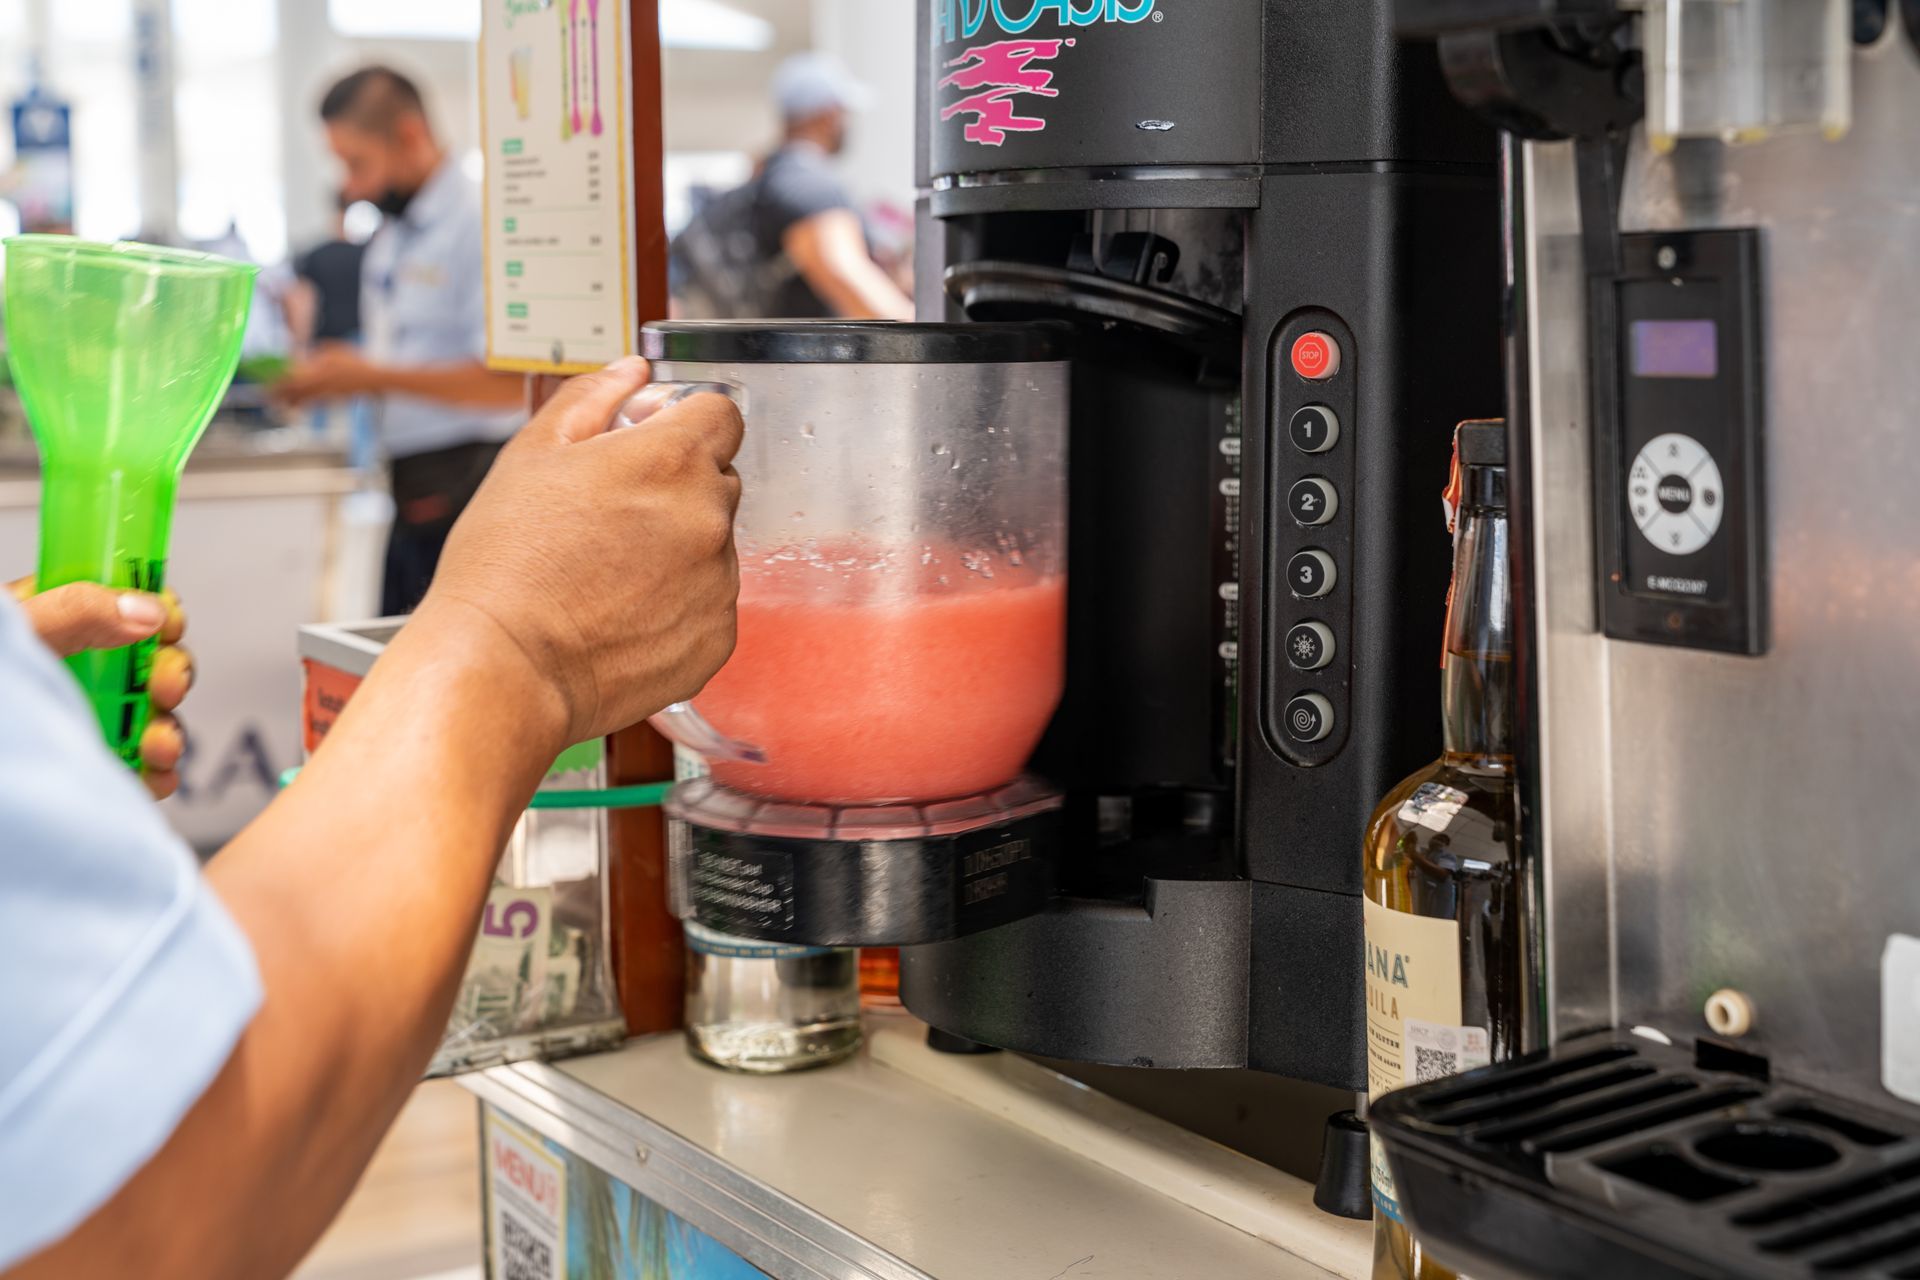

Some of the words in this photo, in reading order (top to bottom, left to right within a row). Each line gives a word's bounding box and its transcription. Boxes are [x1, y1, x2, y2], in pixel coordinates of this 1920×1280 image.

[1301, 351, 1320, 360] STOP
[1303, 421, 1312, 438] 1
[1301, 493, 1314, 511] 2
[1659, 486, 1690, 502] MENU
[1300, 565, 1313, 584] 3
